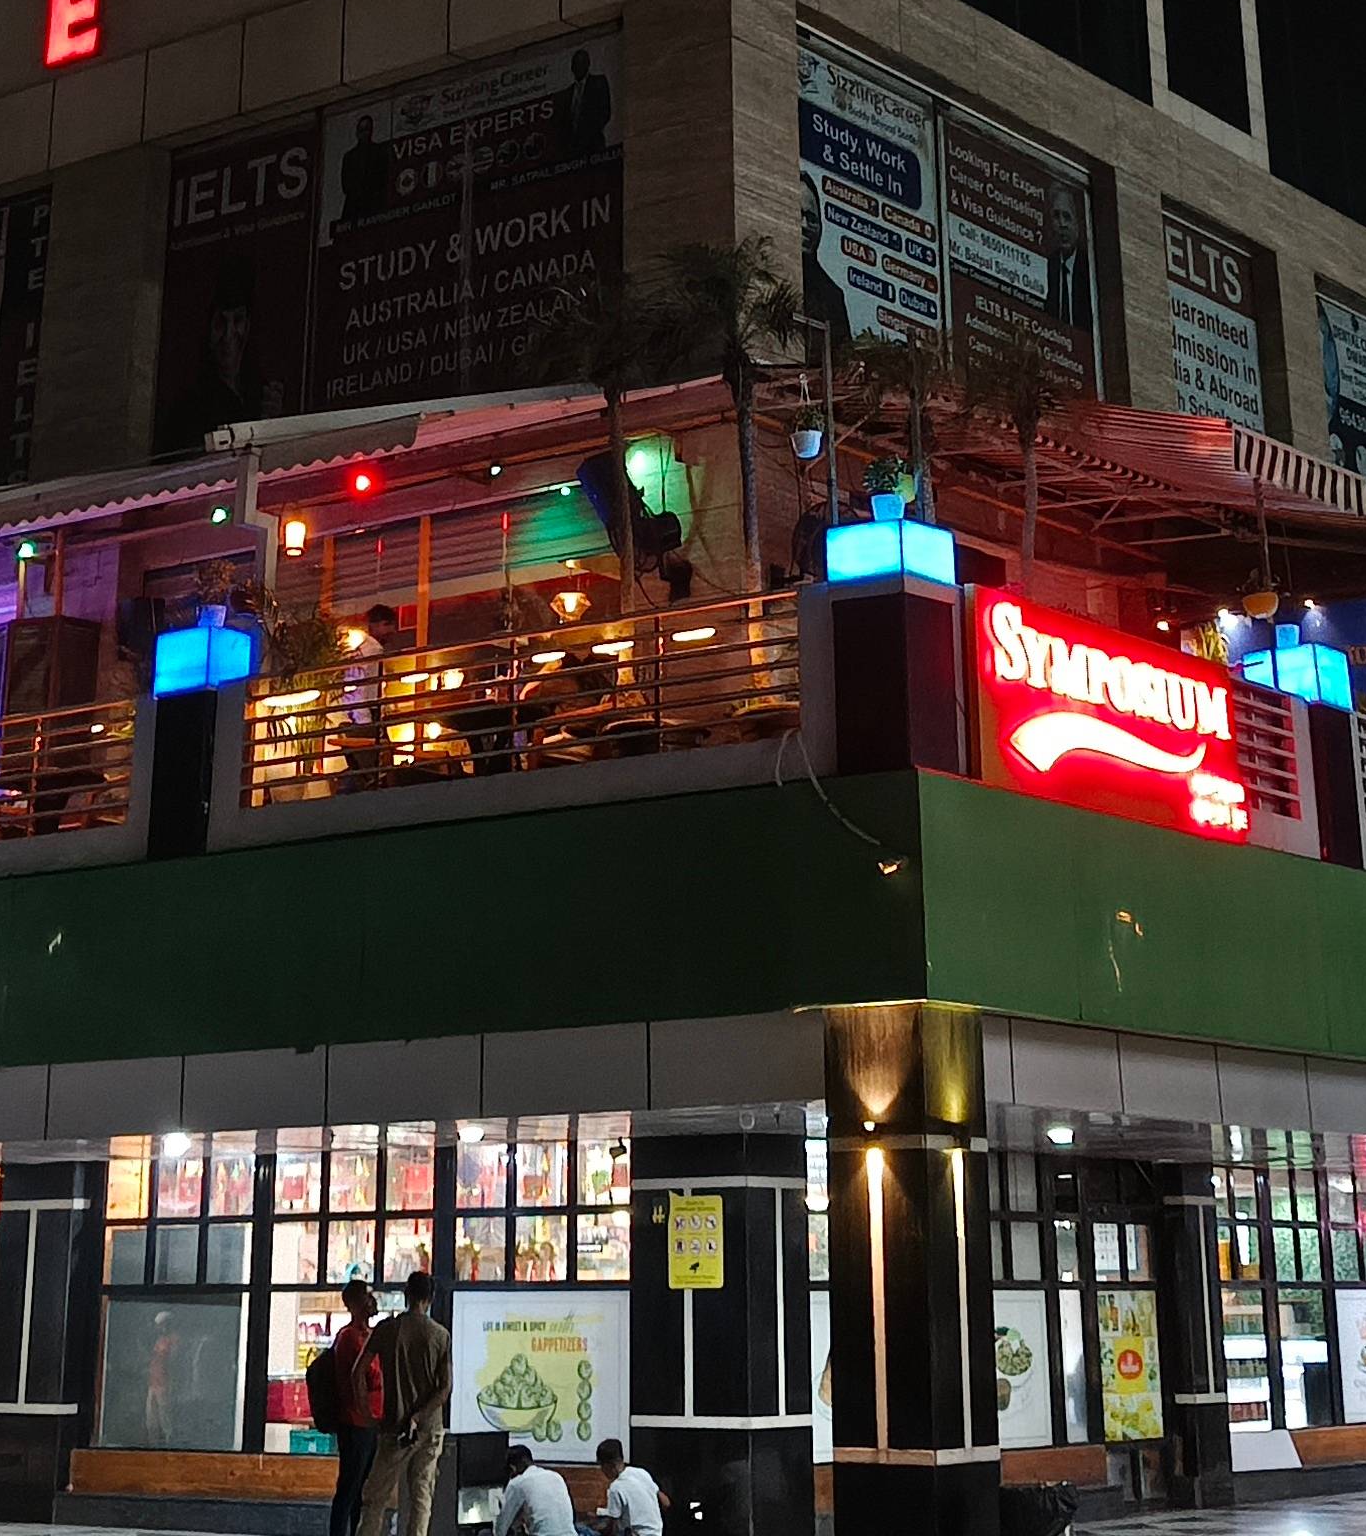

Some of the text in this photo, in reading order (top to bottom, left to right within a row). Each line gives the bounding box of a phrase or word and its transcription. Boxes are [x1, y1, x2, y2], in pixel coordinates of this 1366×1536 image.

[393, 137, 443, 160] VISA
[450, 99, 555, 146] EXPERTS
[812, 113, 908, 174] Study, Work
[822, 144, 903, 197] & Settle In
[948, 139, 991, 178] Looking
[992, 162, 1010, 183] For
[949, 165, 985, 196] Career
[173, 146, 308, 228] IELTS
[950, 188, 959, 207] &
[960, 192, 985, 219] Visa
[27, 205, 50, 291] PTE
[338, 193, 612, 292] STUDY & WORK IN
[827, 205, 890, 245] New Zealand
[842, 238, 867, 260] USA
[907, 241, 922, 259] UK
[345, 278, 475, 332] AUSTRALIA
[494, 249, 596, 293] CANADA
[849, 267, 883, 296] Ireland
[975, 295, 1002, 318] IELTS
[342, 341, 370, 366] UK
[387, 327, 428, 356] USA
[444, 310, 493, 341] NEW
[497, 294, 581, 328] ZEALAN
[326, 361, 412, 401] IRELAND
[430, 343, 494, 378] DUBAI
[1195, 367, 1205, 392] &
[1210, 374, 1260, 416] Abroad
[1242, 359, 1258, 387] in
[991, 601, 1232, 741] SYMPOSIUM
